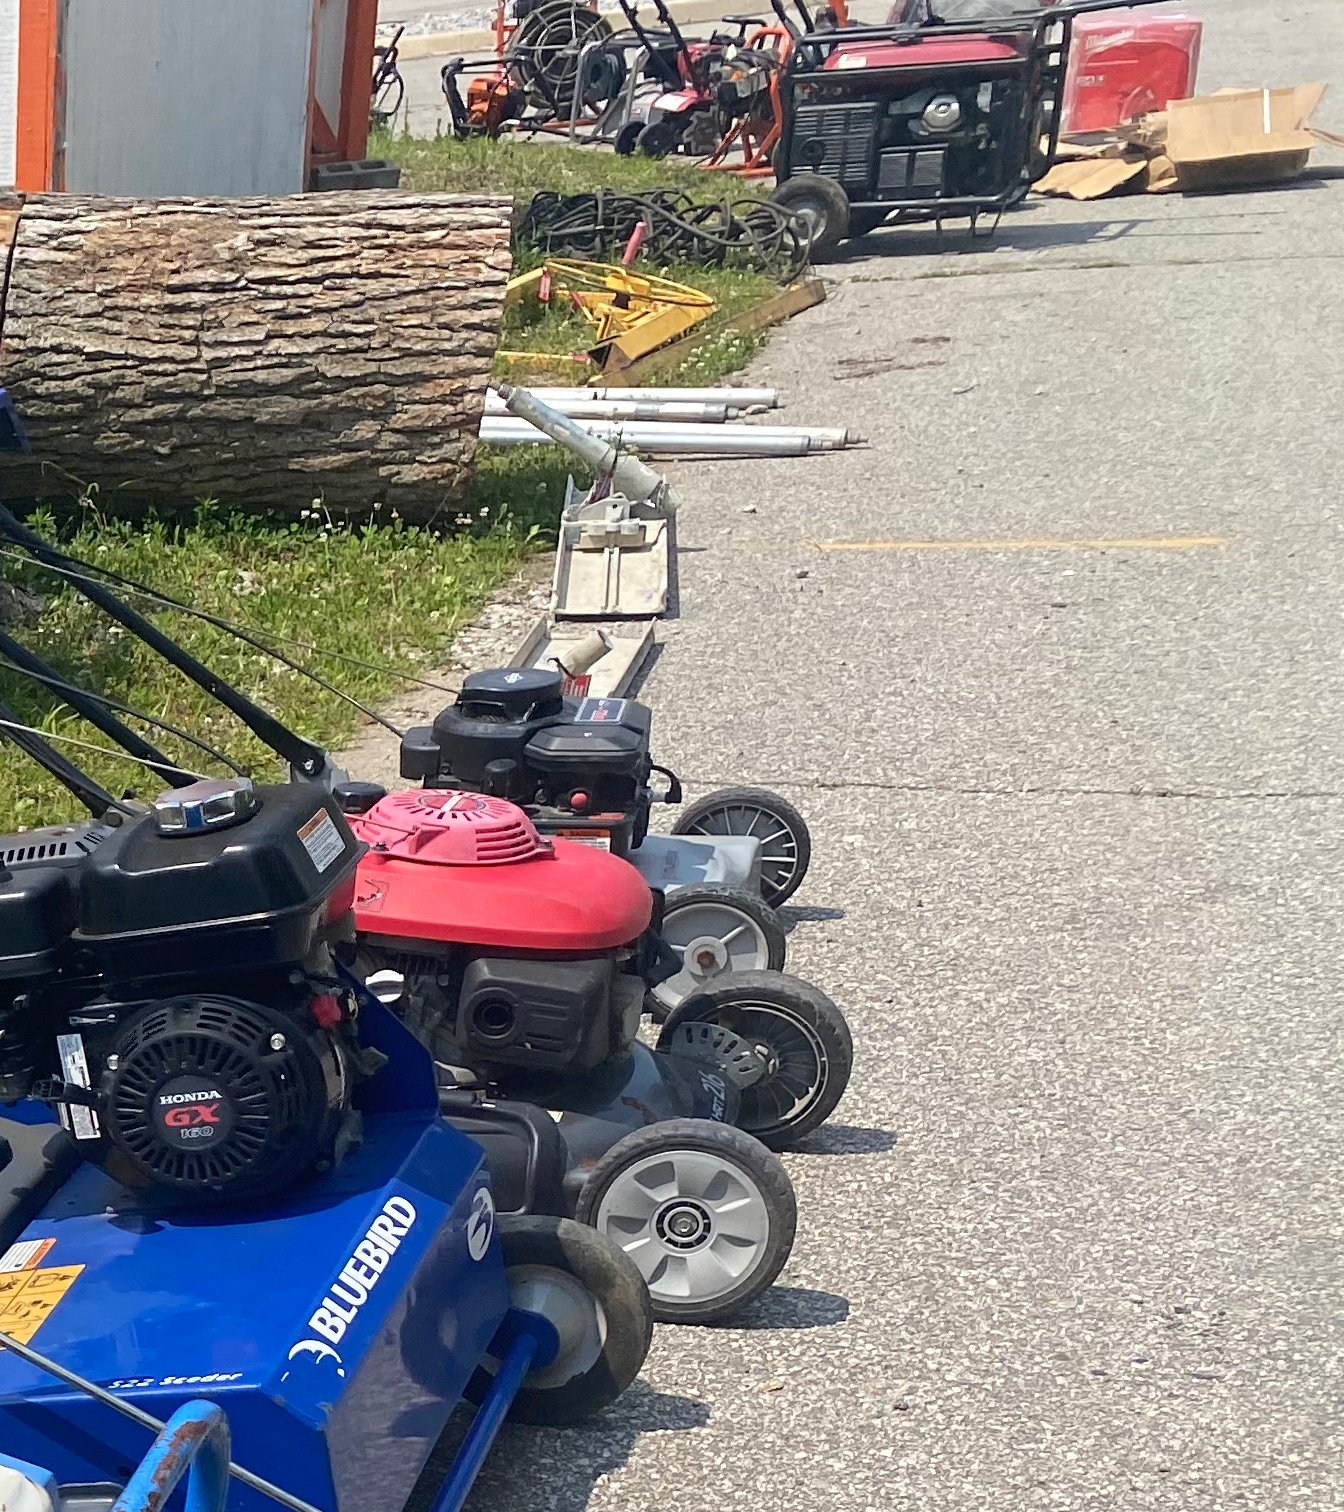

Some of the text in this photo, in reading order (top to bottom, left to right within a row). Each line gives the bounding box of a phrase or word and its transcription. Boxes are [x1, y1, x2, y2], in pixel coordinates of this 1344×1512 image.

[160, 1089, 223, 1105] HONDA
[164, 1103, 221, 1127] GX
[180, 1126, 214, 1140] 160
[308, 1196, 417, 1345] BLUEBIRD
[108, 1379, 155, 1389] S22
